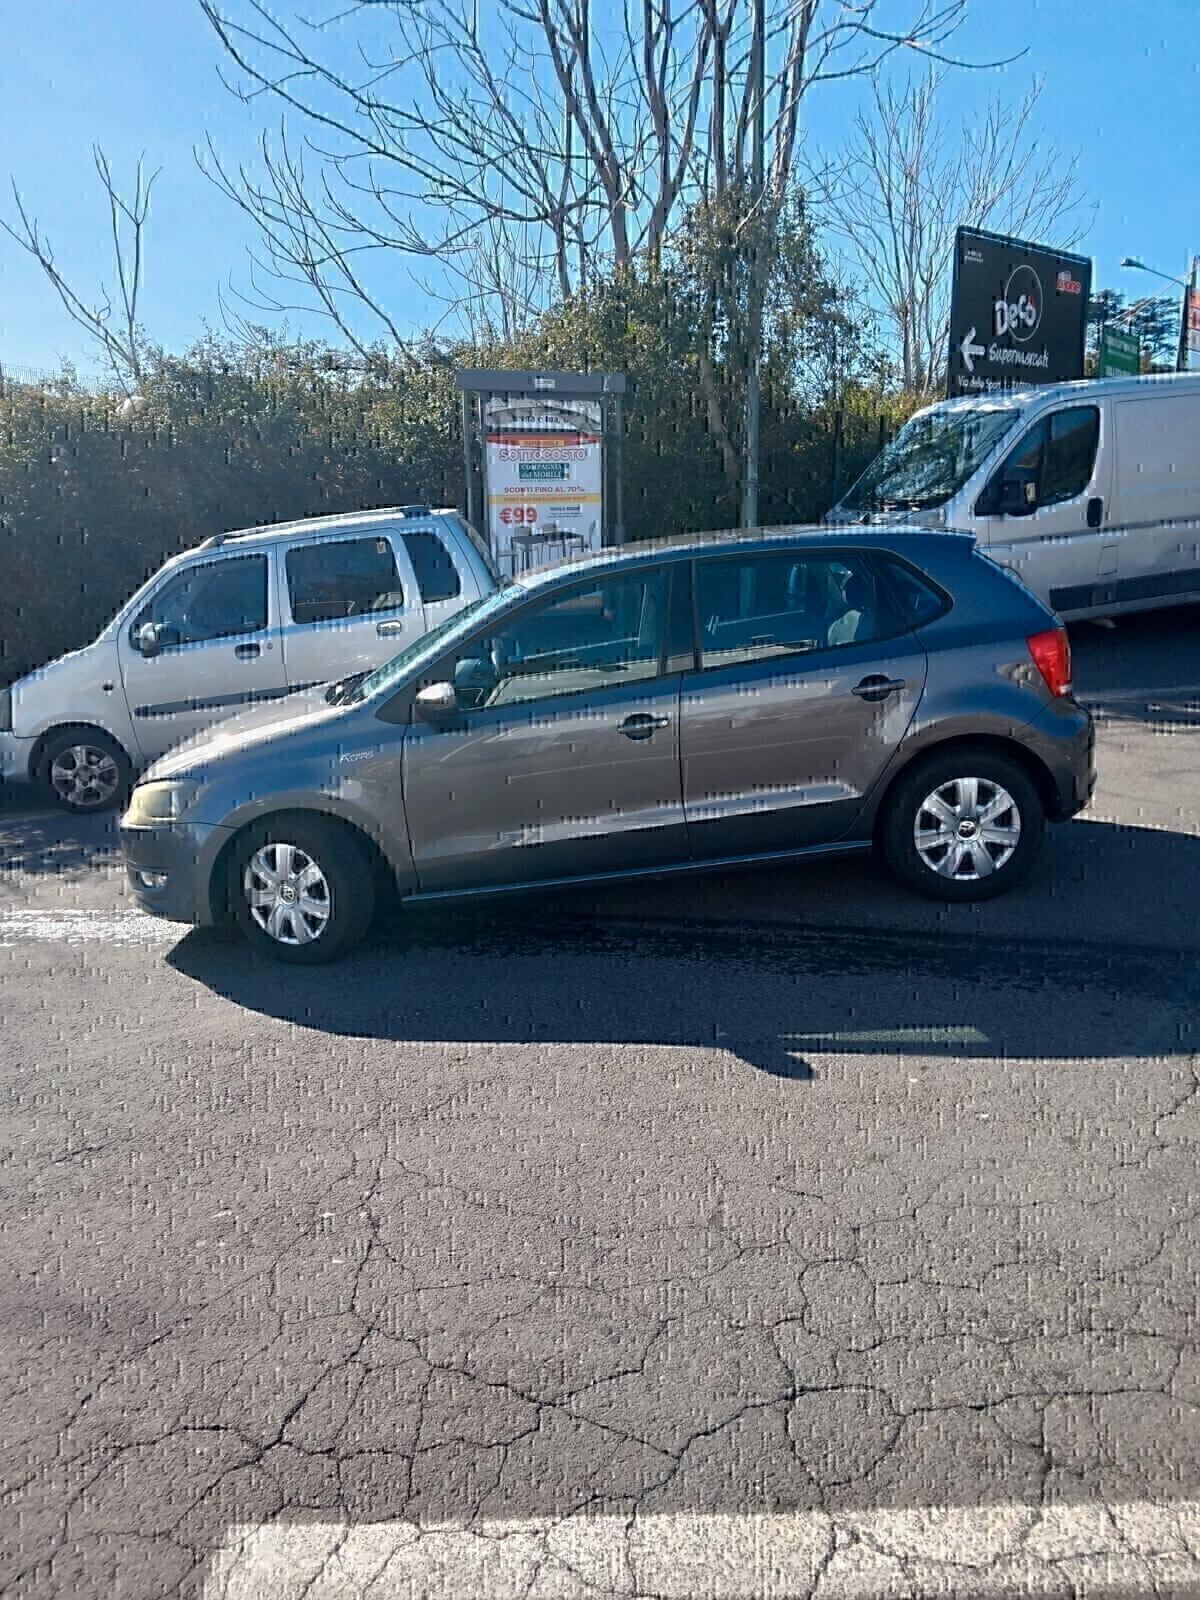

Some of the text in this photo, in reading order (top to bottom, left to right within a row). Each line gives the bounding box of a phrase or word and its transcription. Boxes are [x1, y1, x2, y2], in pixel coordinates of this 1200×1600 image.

[988, 343, 1049, 369] Supermercati
[499, 449, 587, 461] SOTTOCOSTO
[532, 470, 563, 478] MOBILE
[503, 486, 533, 494] SCONTI
[498, 506, 538, 524] €99
